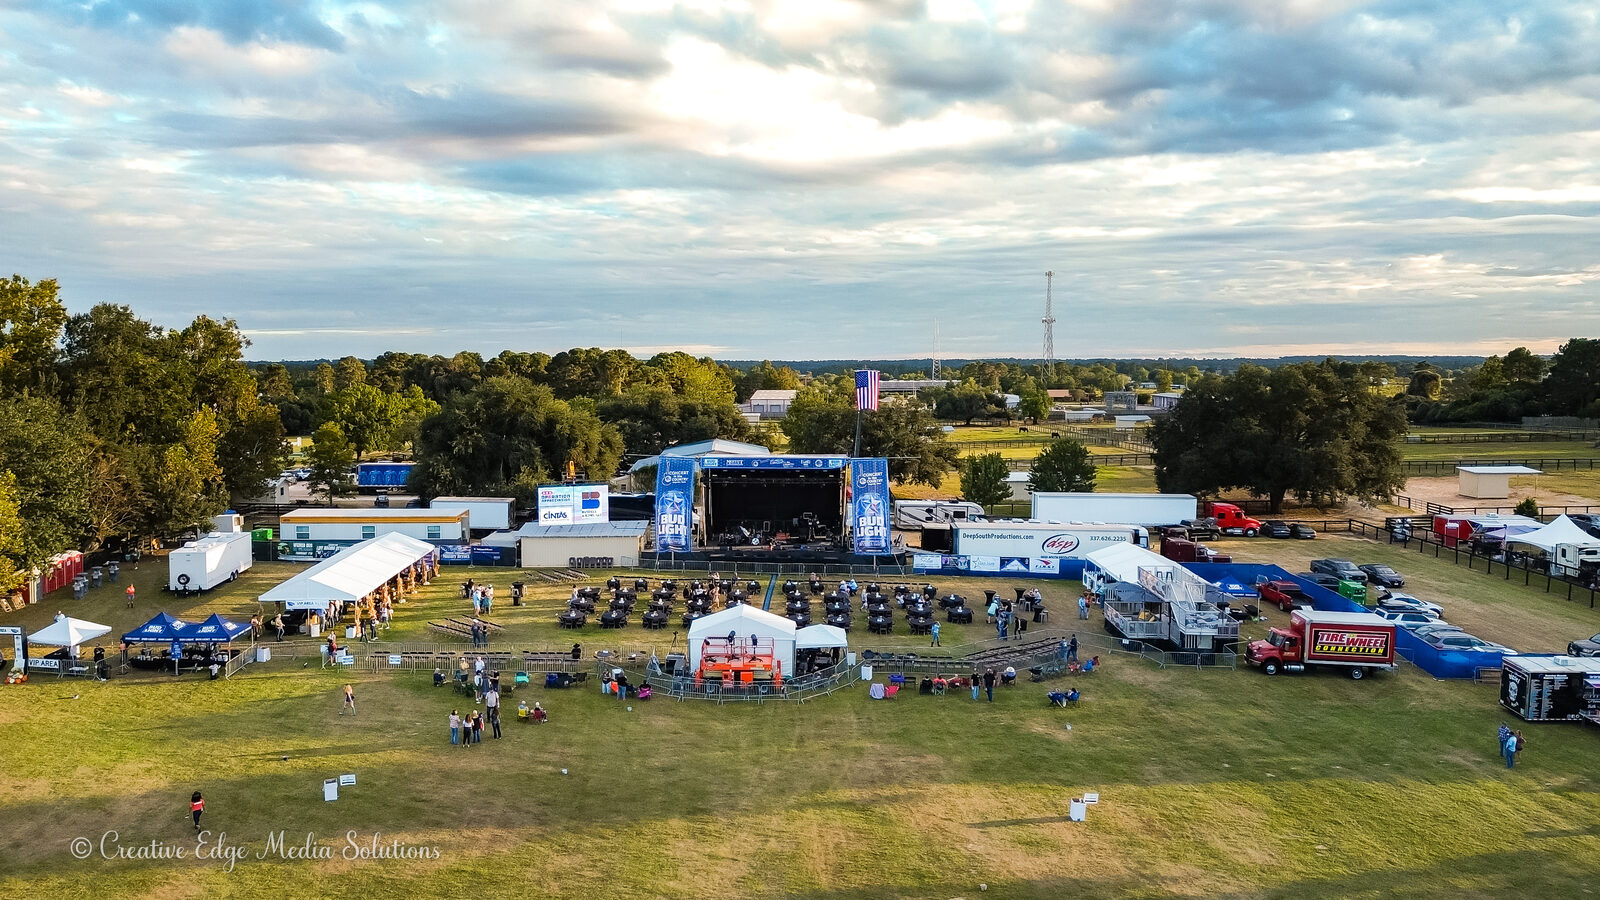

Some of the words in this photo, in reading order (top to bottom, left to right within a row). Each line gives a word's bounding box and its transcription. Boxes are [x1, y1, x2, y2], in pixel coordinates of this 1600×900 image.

[544, 511, 567, 520] CINTAS
[661, 514, 686, 524] BUD
[860, 516, 884, 526] BUD
[658, 524, 688, 536] LIGHT
[857, 526, 887, 537] LIGHT
[1046, 537, 1074, 553] dsp
[1319, 632, 1346, 642] TIRE
[1346, 638, 1385, 648] WHEEL
[1316, 646, 1384, 654] CONNECTION
